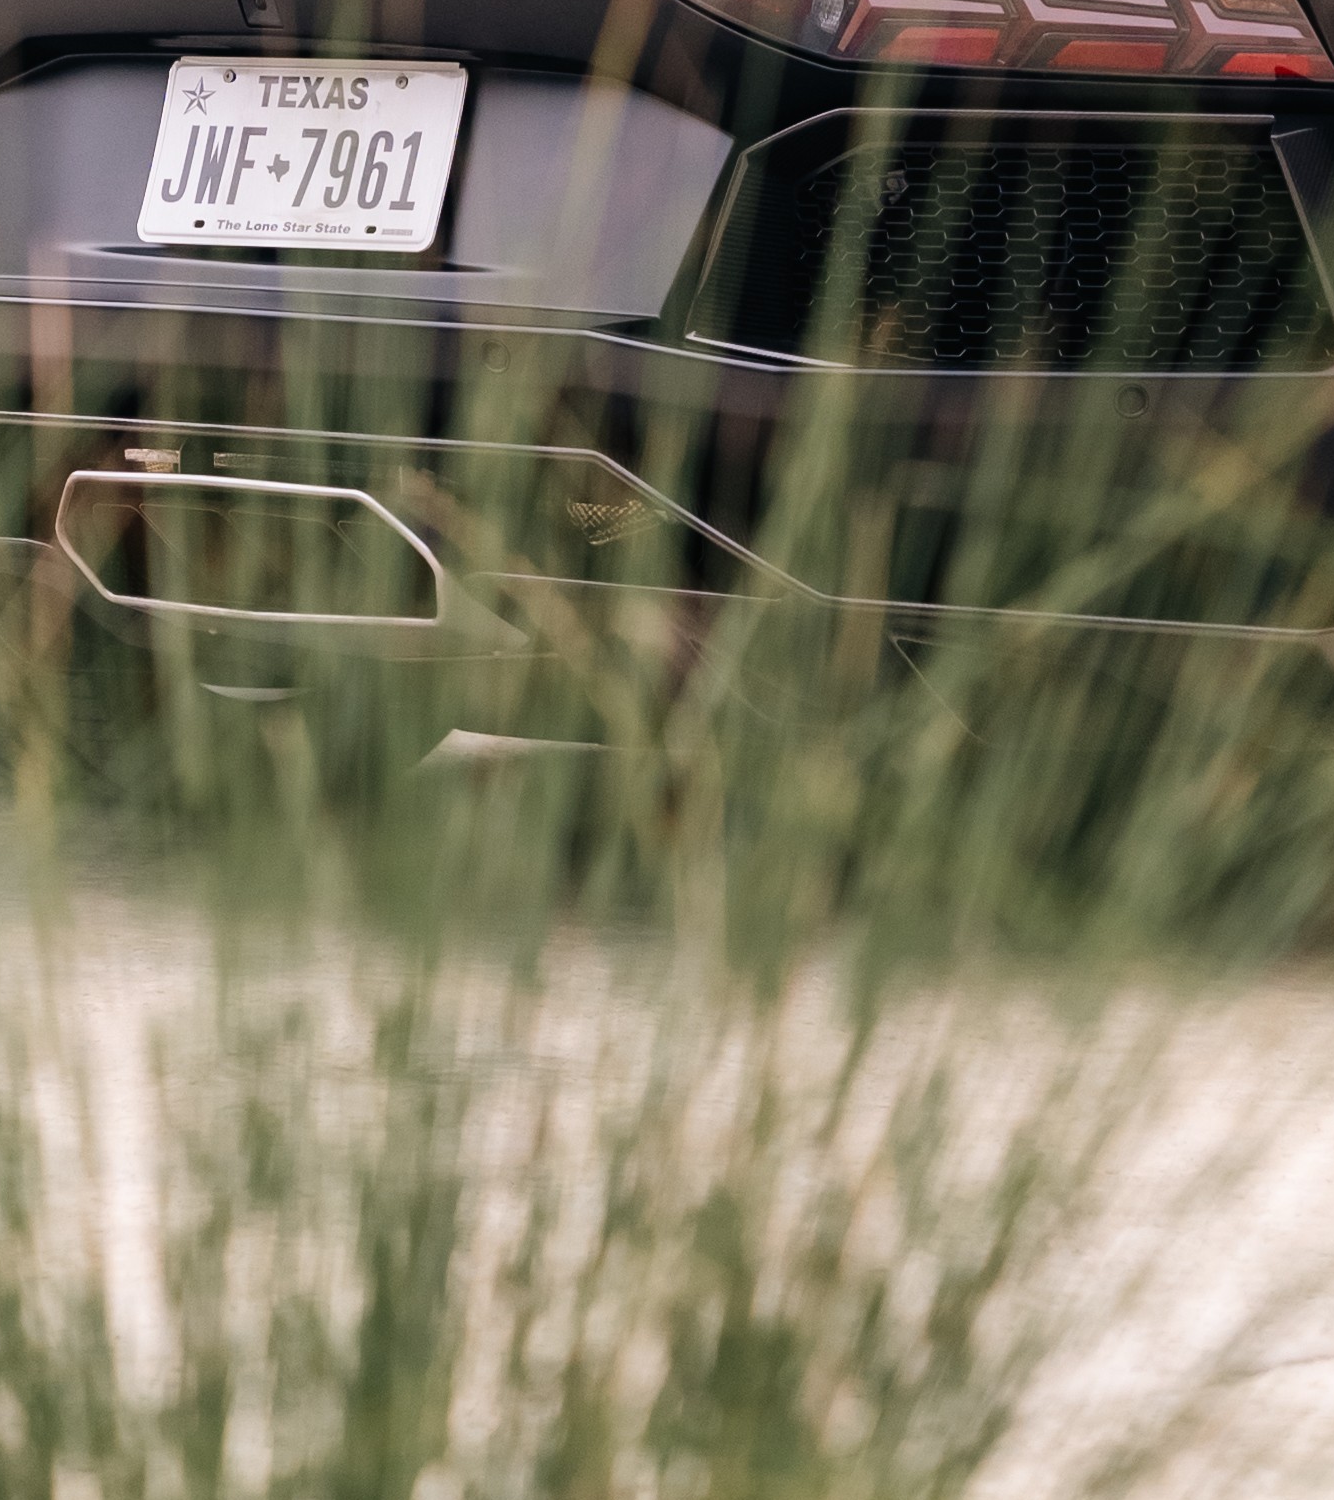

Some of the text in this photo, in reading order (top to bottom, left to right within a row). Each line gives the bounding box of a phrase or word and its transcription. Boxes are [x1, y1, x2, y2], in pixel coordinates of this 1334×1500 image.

[259, 75, 369, 110] TEXAS
[217, 218, 351, 235] The Lone Star State
